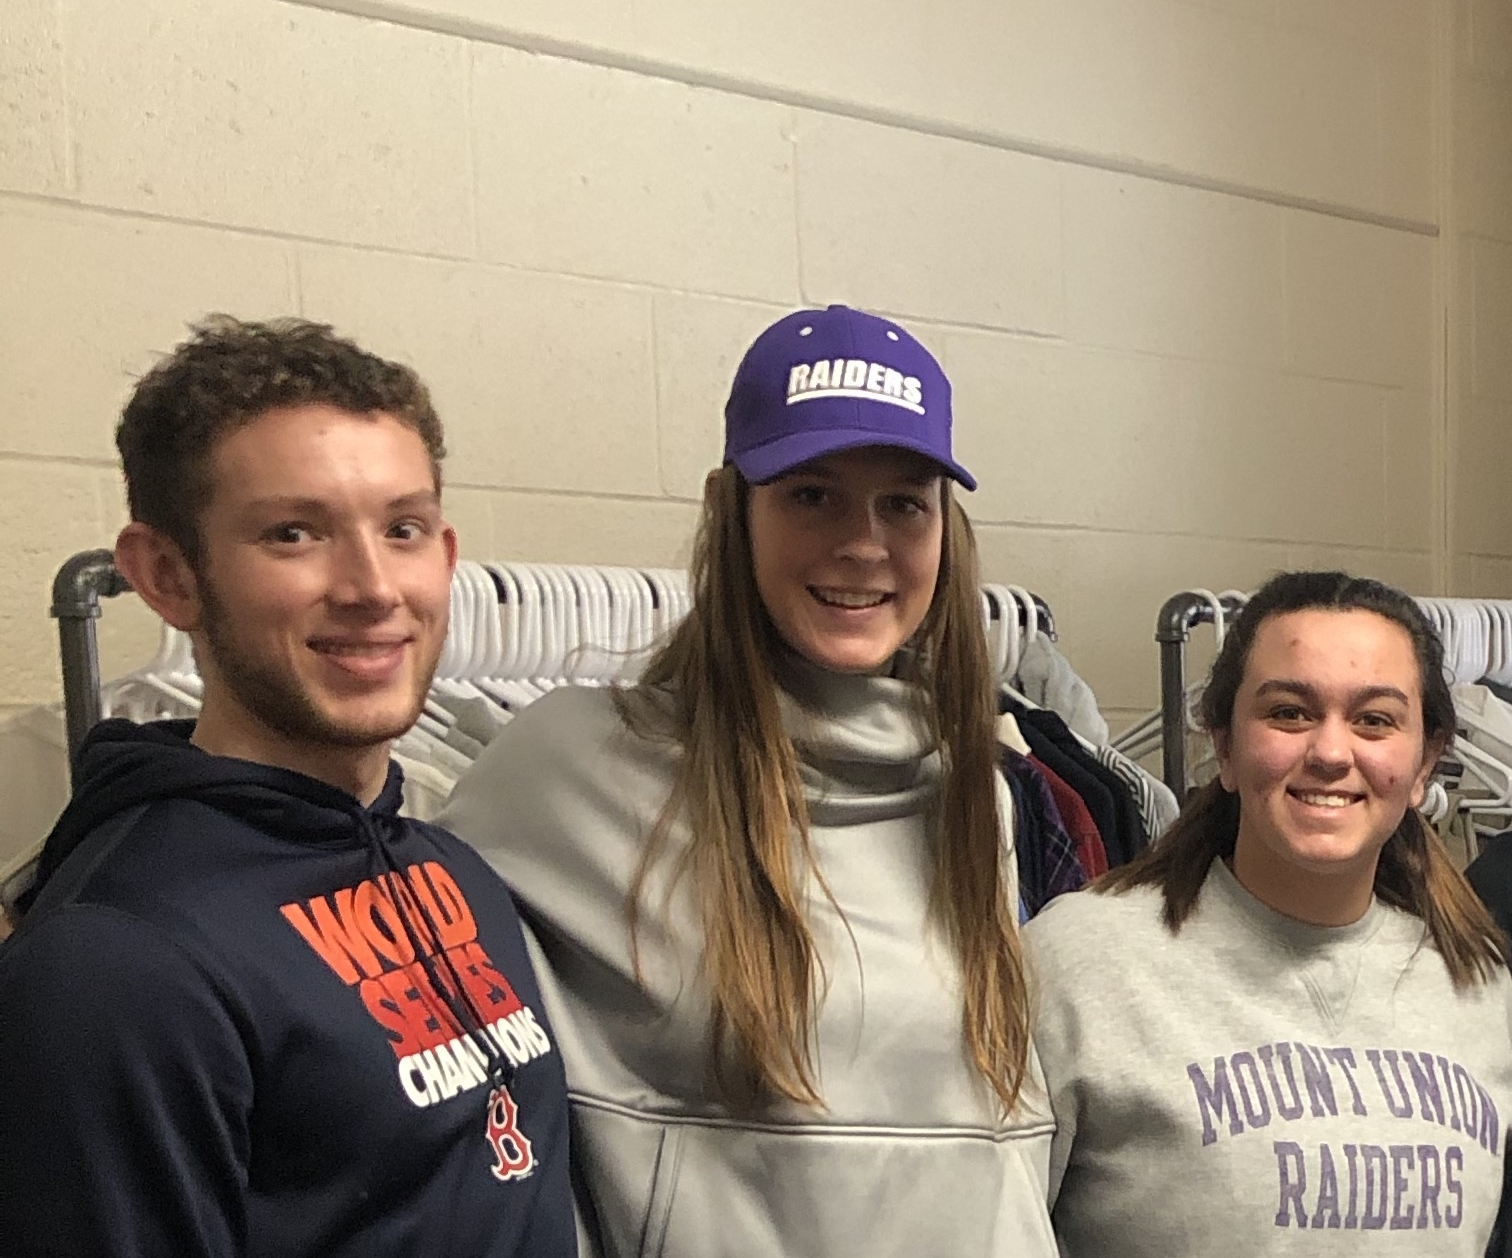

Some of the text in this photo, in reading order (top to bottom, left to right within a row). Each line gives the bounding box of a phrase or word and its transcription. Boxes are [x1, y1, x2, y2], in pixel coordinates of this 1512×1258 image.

[787, 358, 923, 404] RAIDERS
[485, 1084, 534, 1181] B
[1186, 1041, 1499, 1156] MOUNT UNION
[1273, 1140, 1463, 1230] RAIDERS
